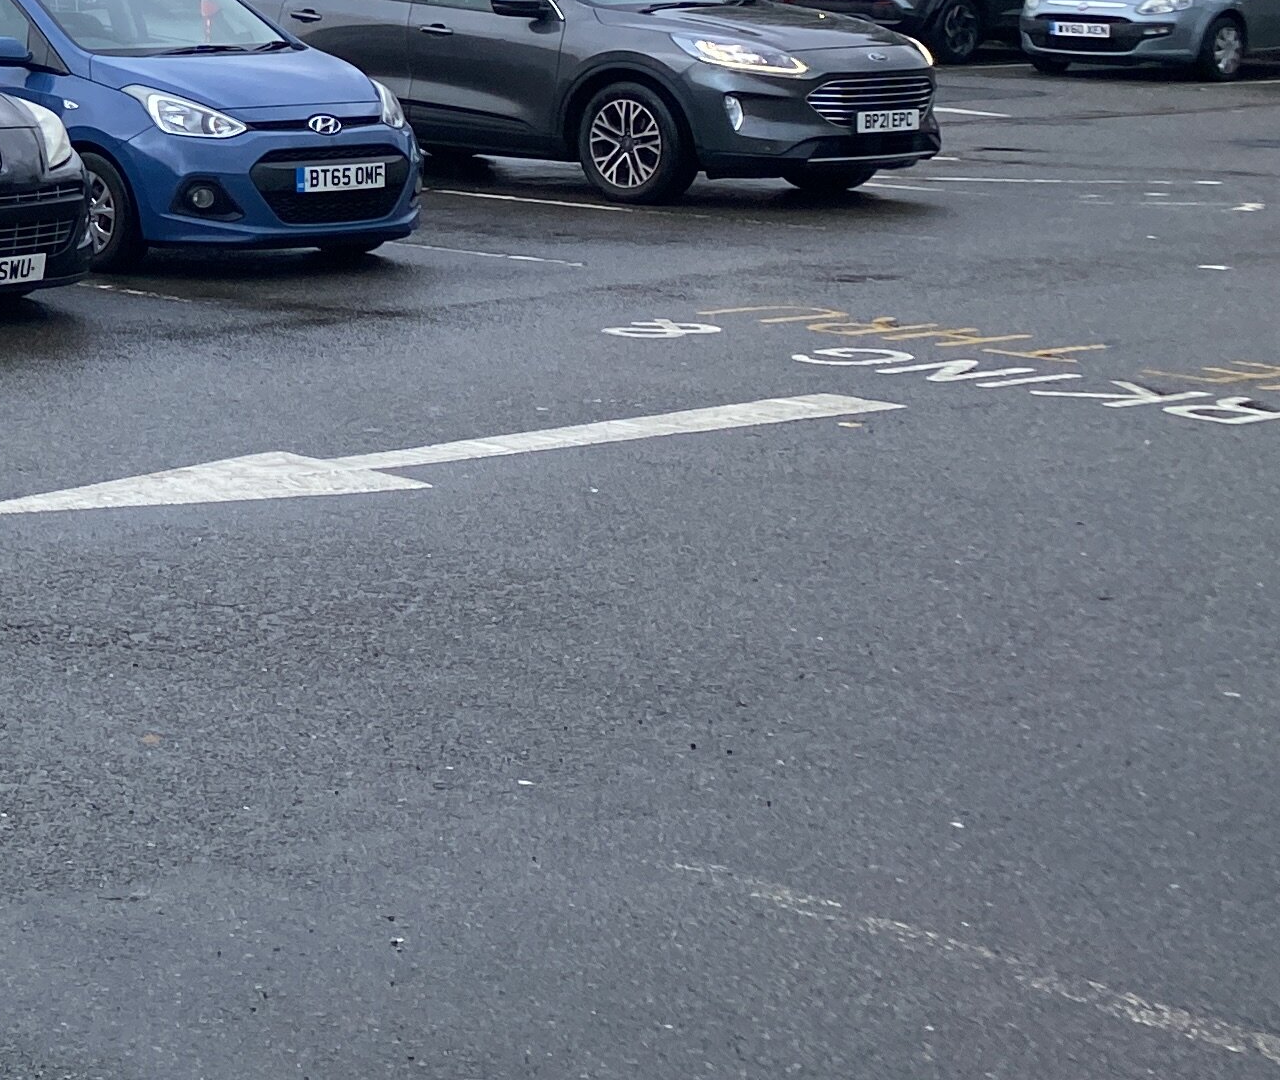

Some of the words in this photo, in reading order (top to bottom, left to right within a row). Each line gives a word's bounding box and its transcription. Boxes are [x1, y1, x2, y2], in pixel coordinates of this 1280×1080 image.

[864, 112, 890, 129] BP21
[891, 111, 913, 128] EPC
[309, 167, 351, 188] BT65
[355, 165, 384, 185] OMF
